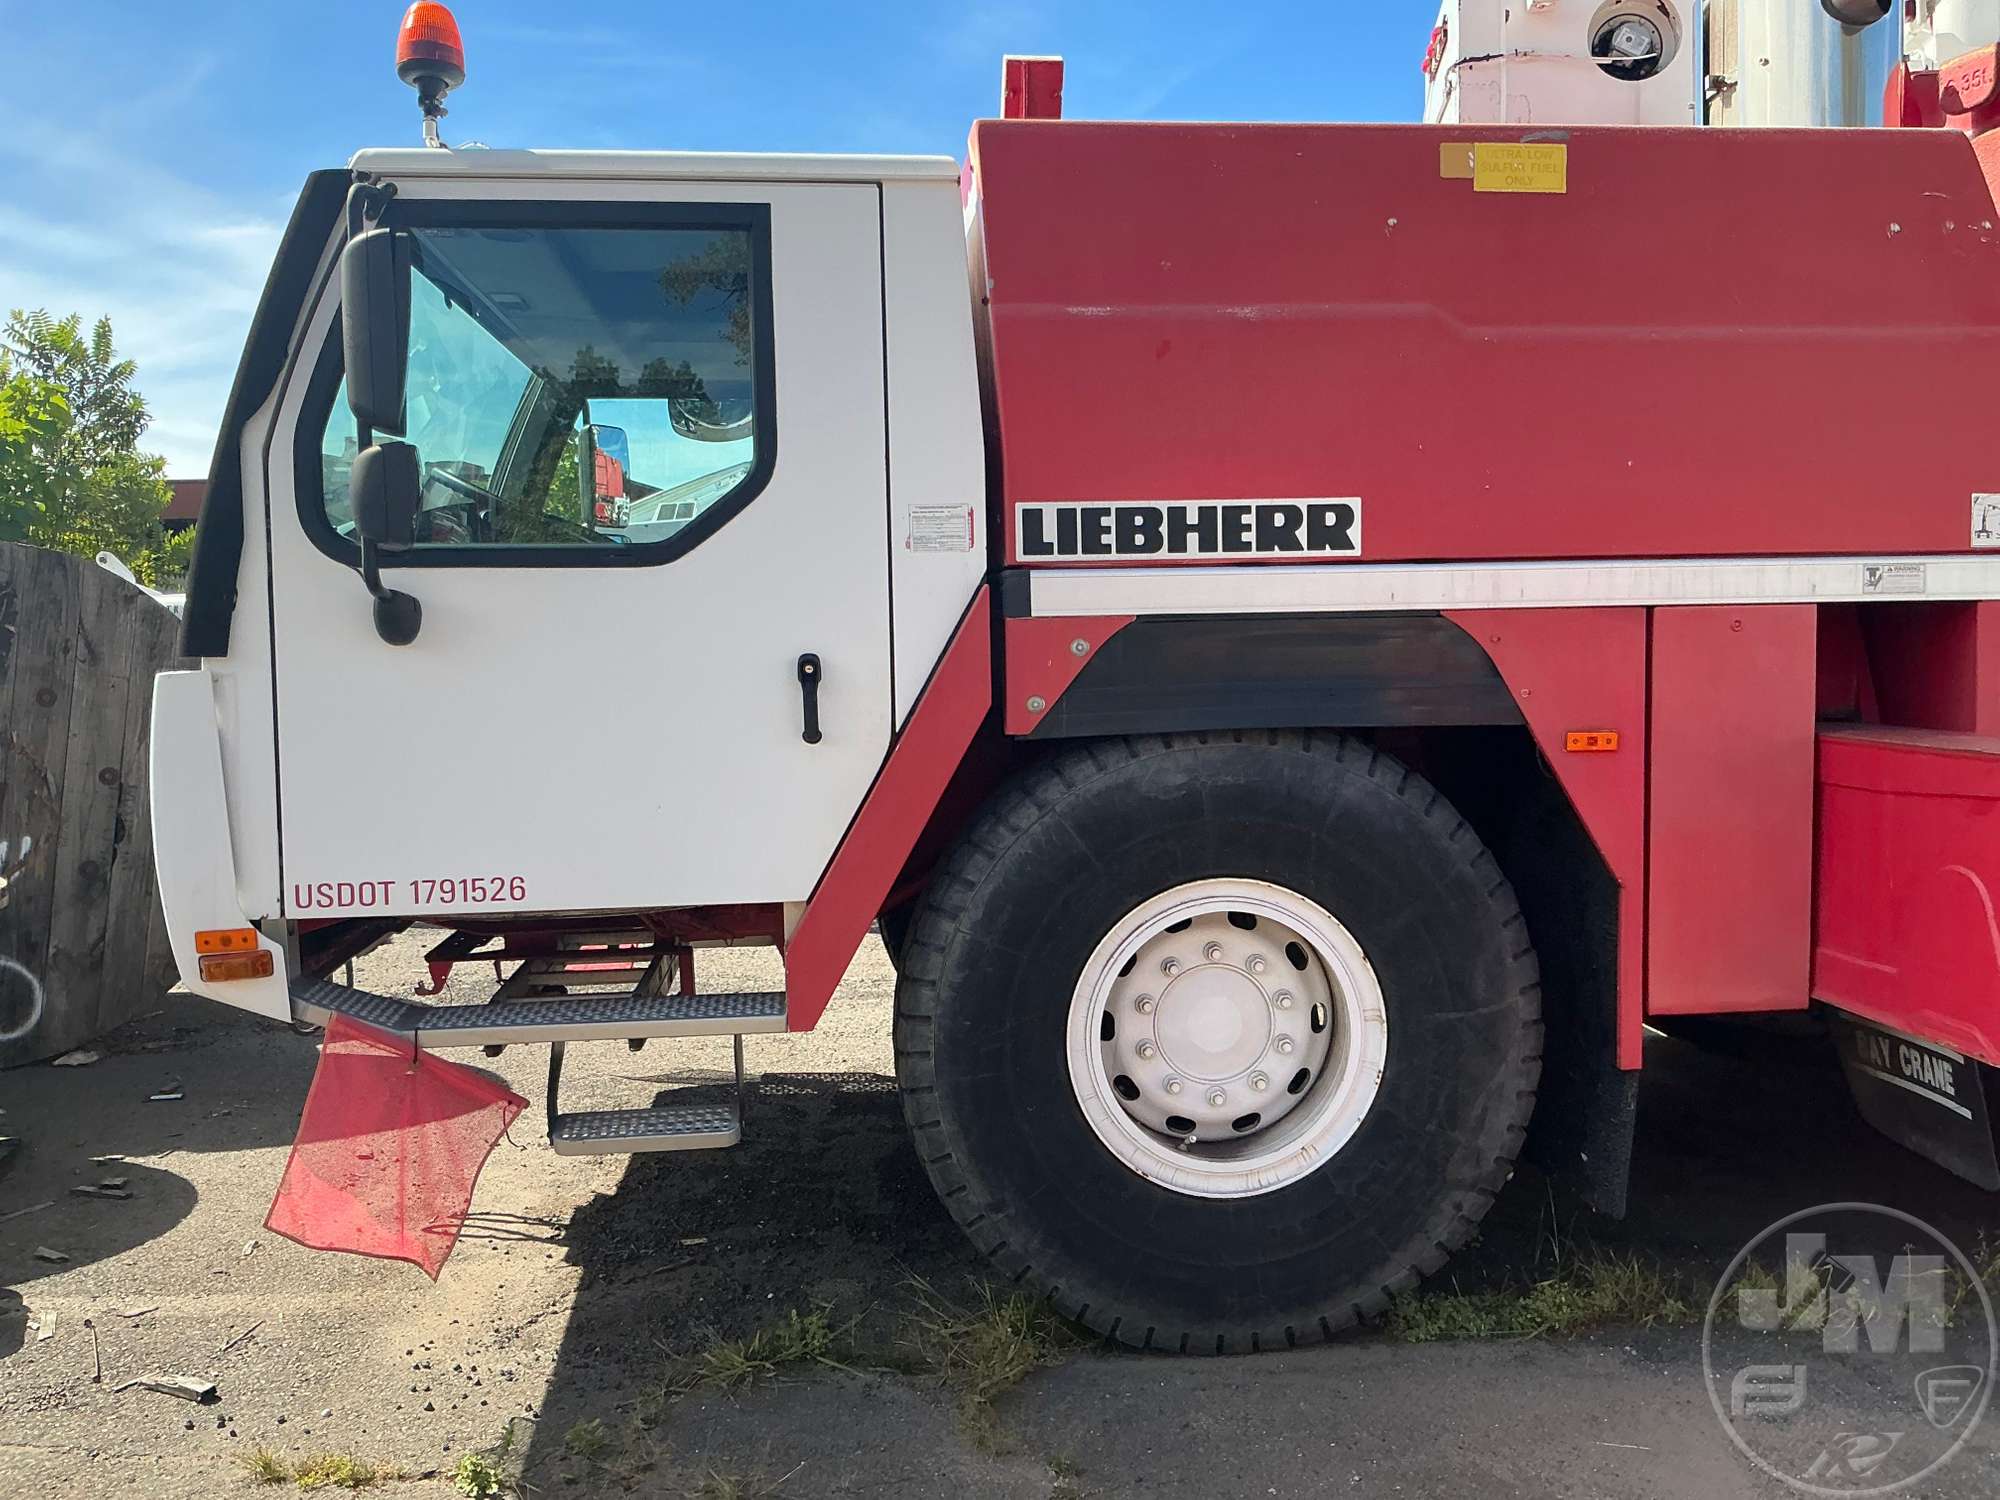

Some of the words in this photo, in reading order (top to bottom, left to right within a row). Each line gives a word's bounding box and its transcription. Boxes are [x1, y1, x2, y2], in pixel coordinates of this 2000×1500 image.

[1484, 149, 1522, 160] ULTRA
[1527, 150, 1553, 160] LOW
[1530, 162, 1560, 174] FUEL
[1504, 175, 1534, 186] ONLY
[1021, 503, 1356, 556] LIEBHERR
[294, 880, 396, 909] USDOT
[409, 876, 527, 905] 1791526
[1898, 1043, 1956, 1097] CRANE
